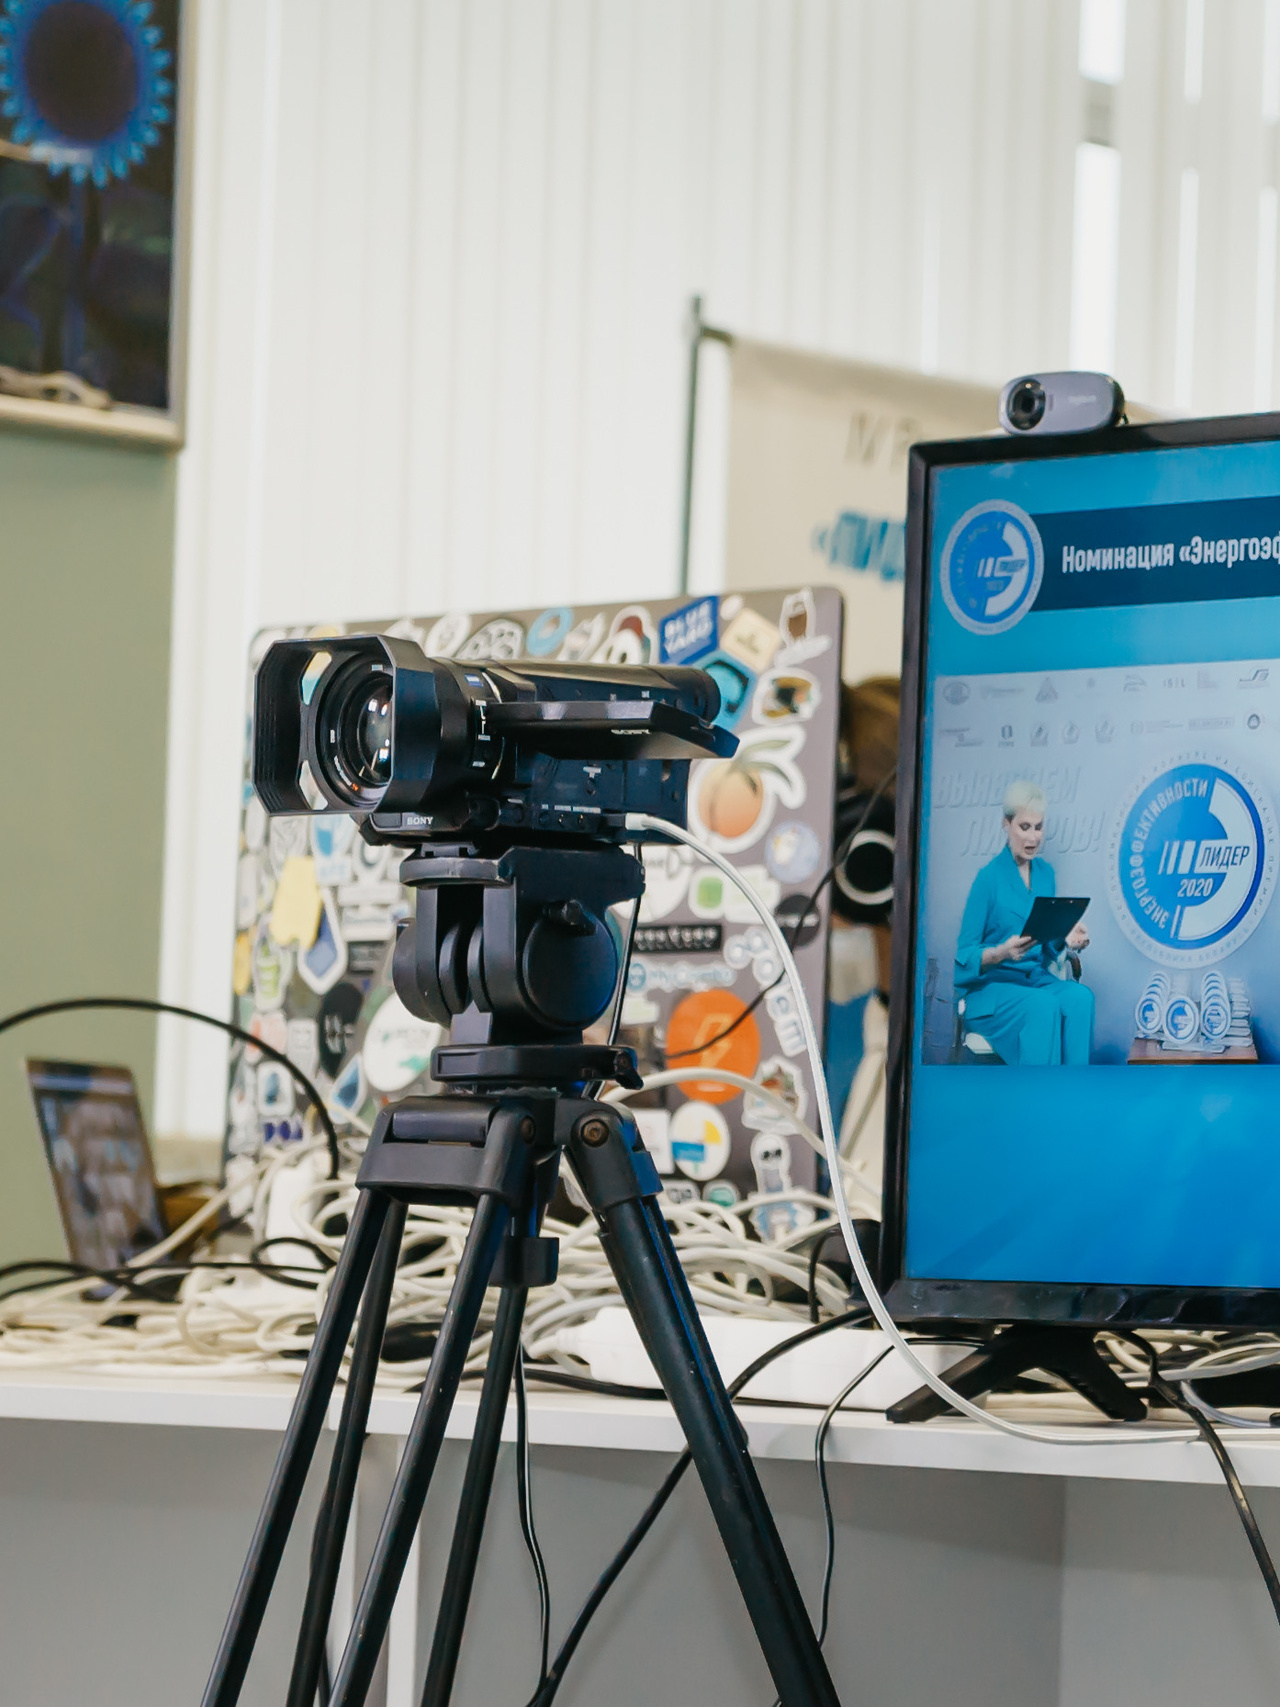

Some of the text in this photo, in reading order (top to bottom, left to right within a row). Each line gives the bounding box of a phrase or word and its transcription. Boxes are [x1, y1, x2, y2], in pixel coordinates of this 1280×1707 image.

[1062, 543, 1175, 574] Номинация
[407, 816, 434, 826] SONY
[1199, 846, 1250, 869] ЛИДЕР
[1177, 878, 1214, 897] 2020
